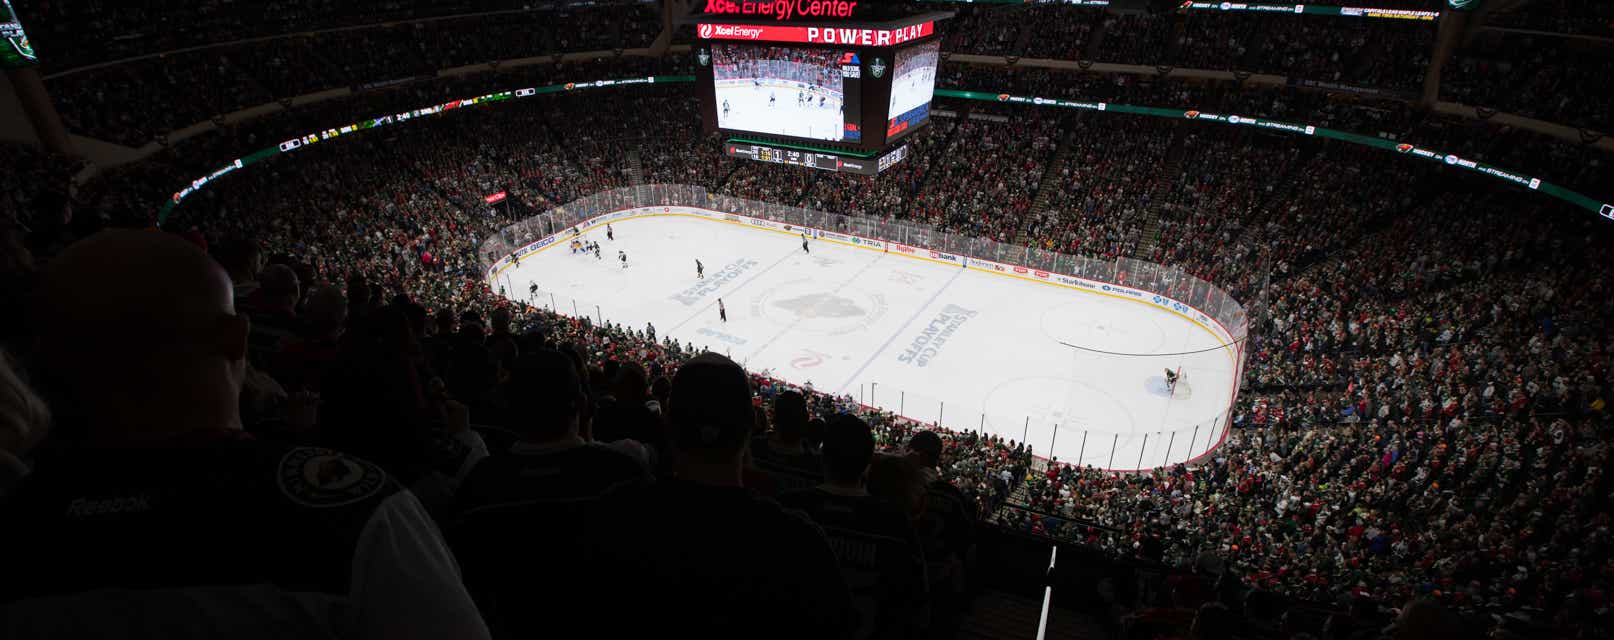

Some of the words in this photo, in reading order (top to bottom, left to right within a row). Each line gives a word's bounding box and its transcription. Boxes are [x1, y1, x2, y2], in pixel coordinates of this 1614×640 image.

[743, 0, 794, 20] Energy
[797, 0, 857, 17] Center
[715, 25, 734, 36] Xcel
[734, 26, 761, 39] Energy
[807, 27, 890, 46] POWER
[895, 23, 923, 43] PLAY
[396, 112, 410, 121] 2:40
[787, 150, 800, 158] 2:40
[806, 154, 812, 163] 0
[1487, 167, 1523, 183] STREAMING
[530, 236, 555, 251] GEICO
[863, 239, 882, 249] TRIA
[897, 313, 952, 365] PLAYOFFS
[932, 314, 968, 350] STANLEY
[916, 347, 938, 368] CUP
[64, 492, 153, 520] Reebok
